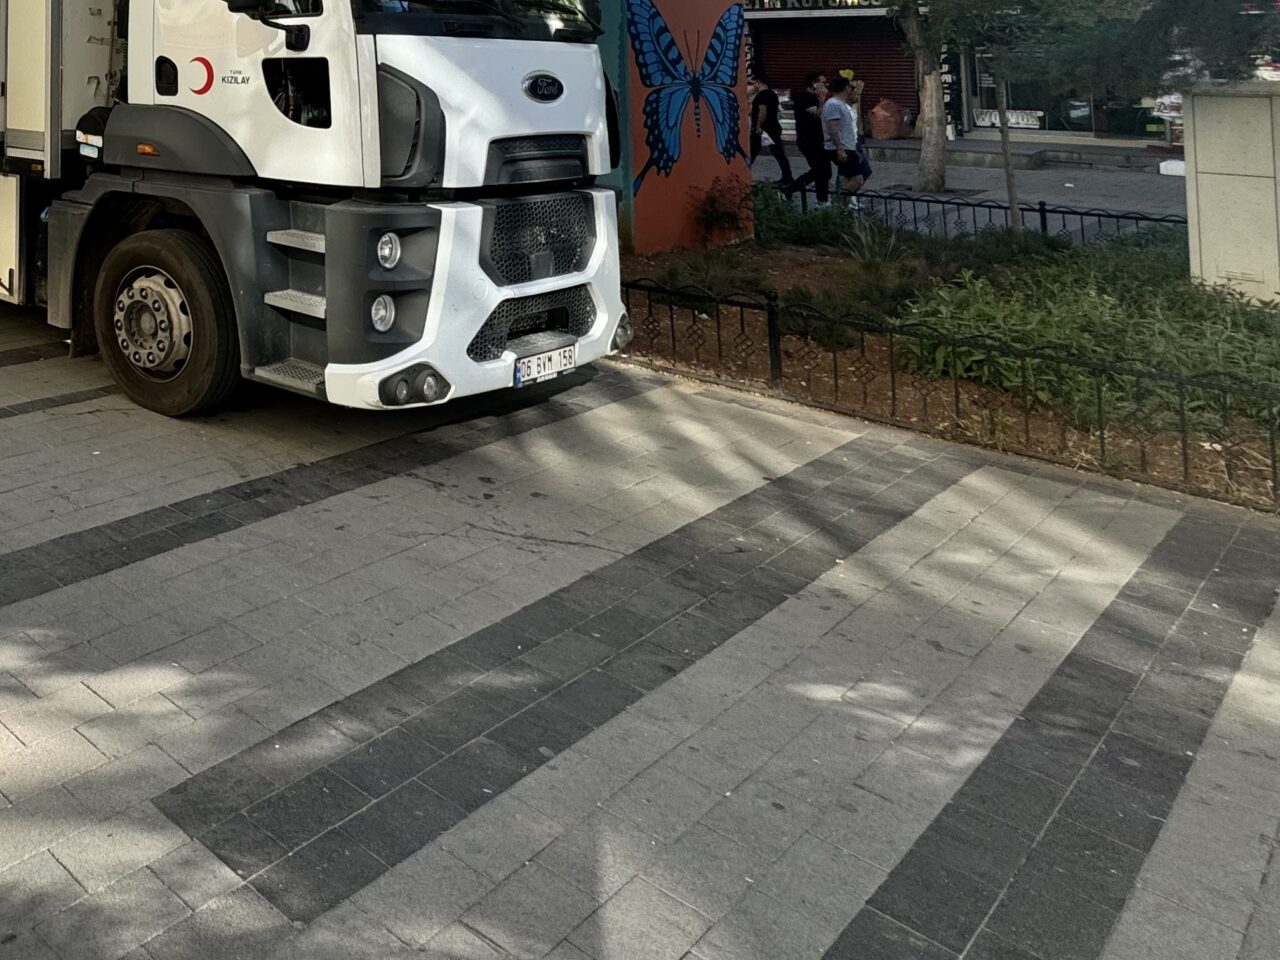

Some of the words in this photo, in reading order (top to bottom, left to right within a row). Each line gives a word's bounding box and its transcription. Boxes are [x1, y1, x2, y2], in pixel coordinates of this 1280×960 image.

[221, 75, 250, 85] KIZILAY
[521, 359, 532, 378] 06
[536, 353, 553, 375] BVM
[558, 348, 573, 368] 158
